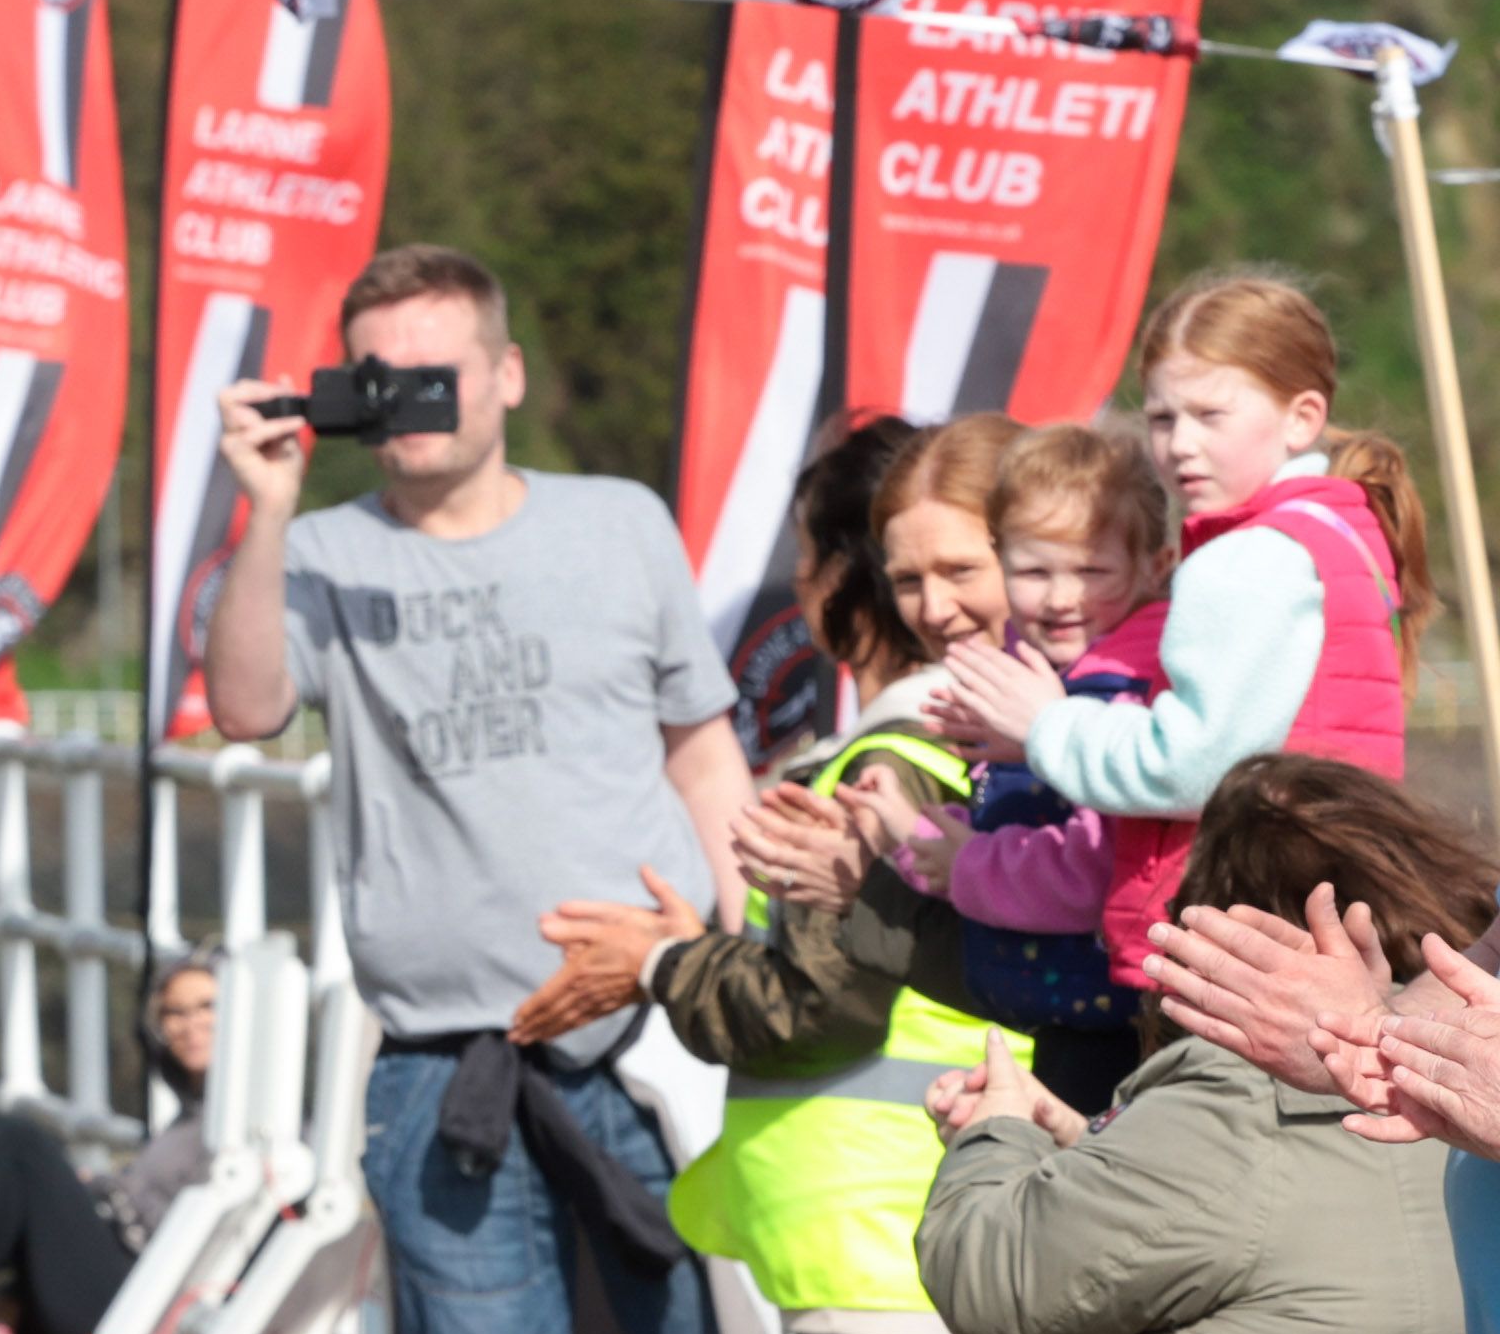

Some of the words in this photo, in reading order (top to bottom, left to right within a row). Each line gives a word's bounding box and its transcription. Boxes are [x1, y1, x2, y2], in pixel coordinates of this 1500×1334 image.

[892, 67, 1157, 140] ATHLETI
[879, 141, 1043, 207] CLUB
[740, 176, 830, 248] CLU
[451, 632, 552, 701] AND
[394, 695, 549, 767] OVER
